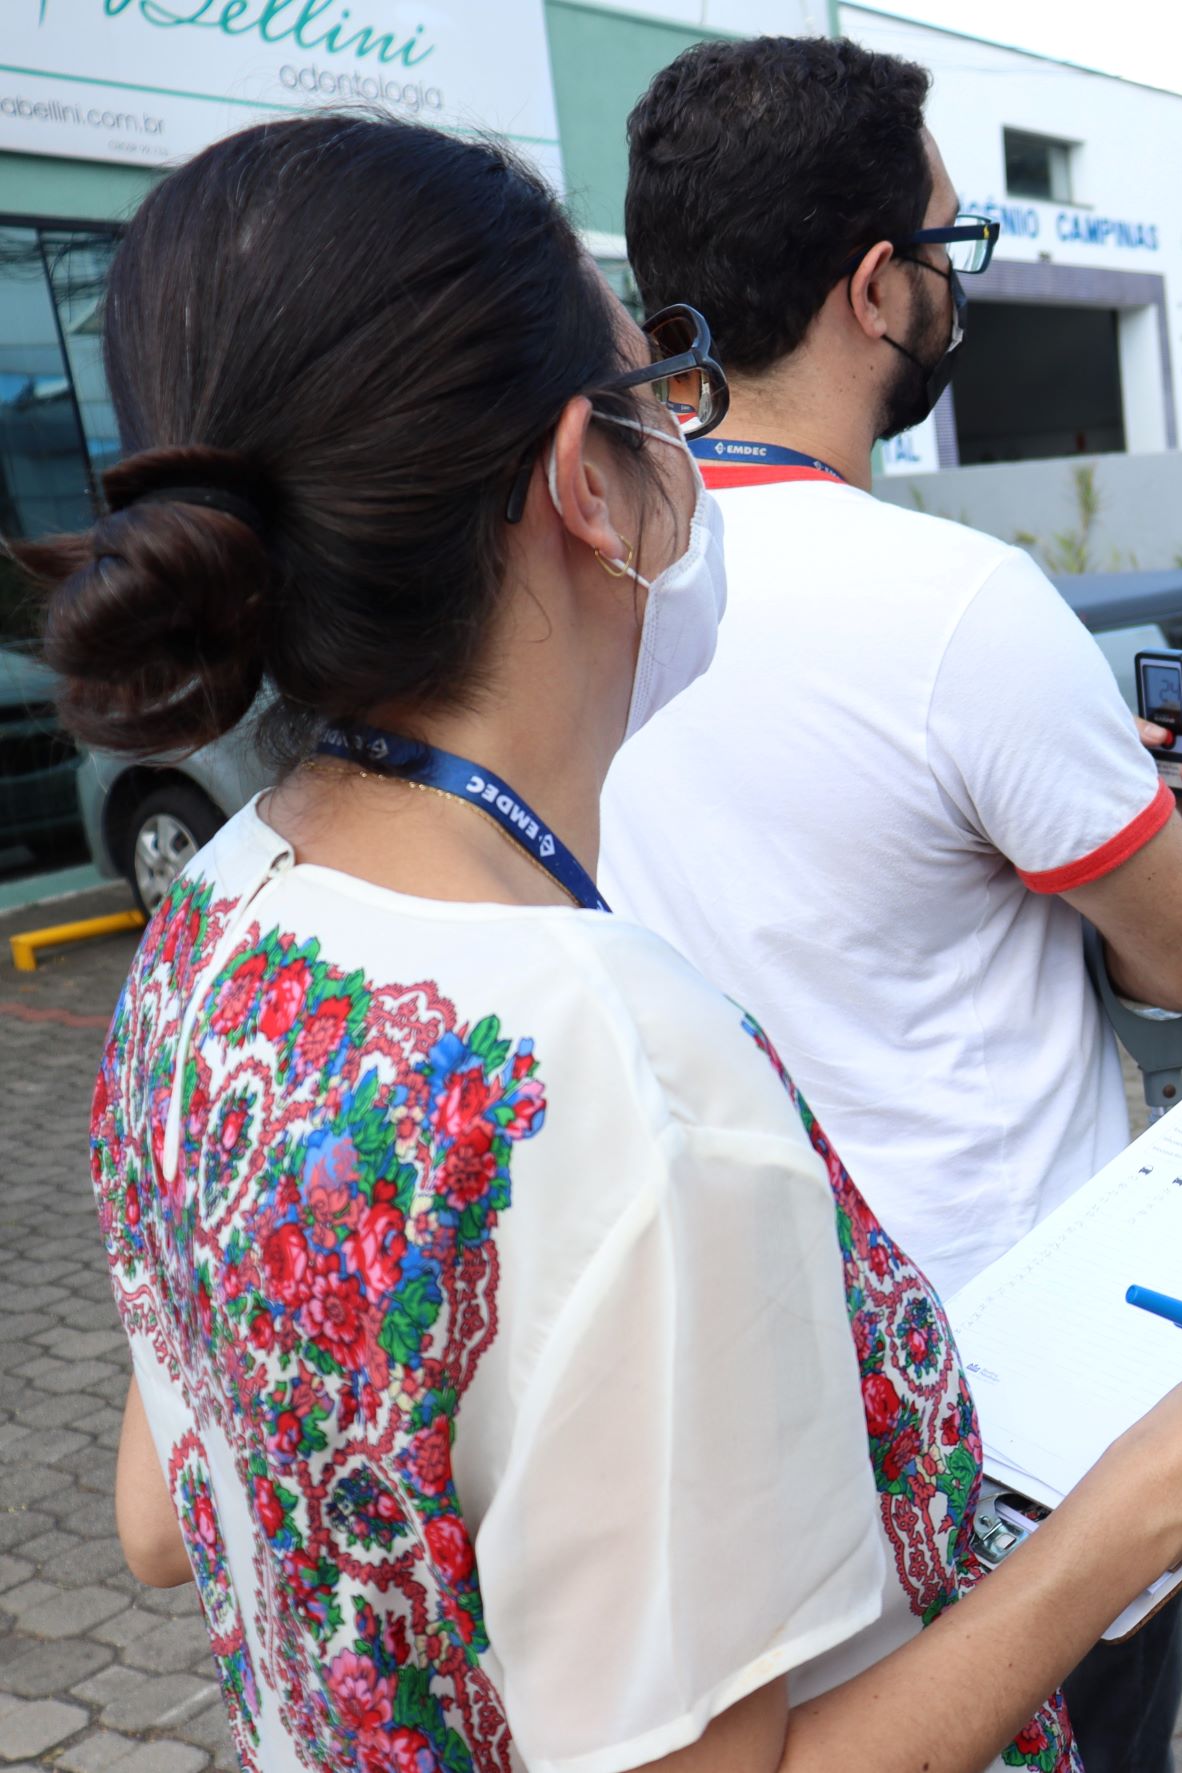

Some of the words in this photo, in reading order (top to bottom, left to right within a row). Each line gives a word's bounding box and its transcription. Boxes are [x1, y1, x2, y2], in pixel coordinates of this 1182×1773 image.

[279, 62, 443, 113] odontologia
[1056, 210, 1160, 252] CAMPINAS
[727, 444, 768, 457] EMDEC
[466, 775, 540, 841] EMDEC
